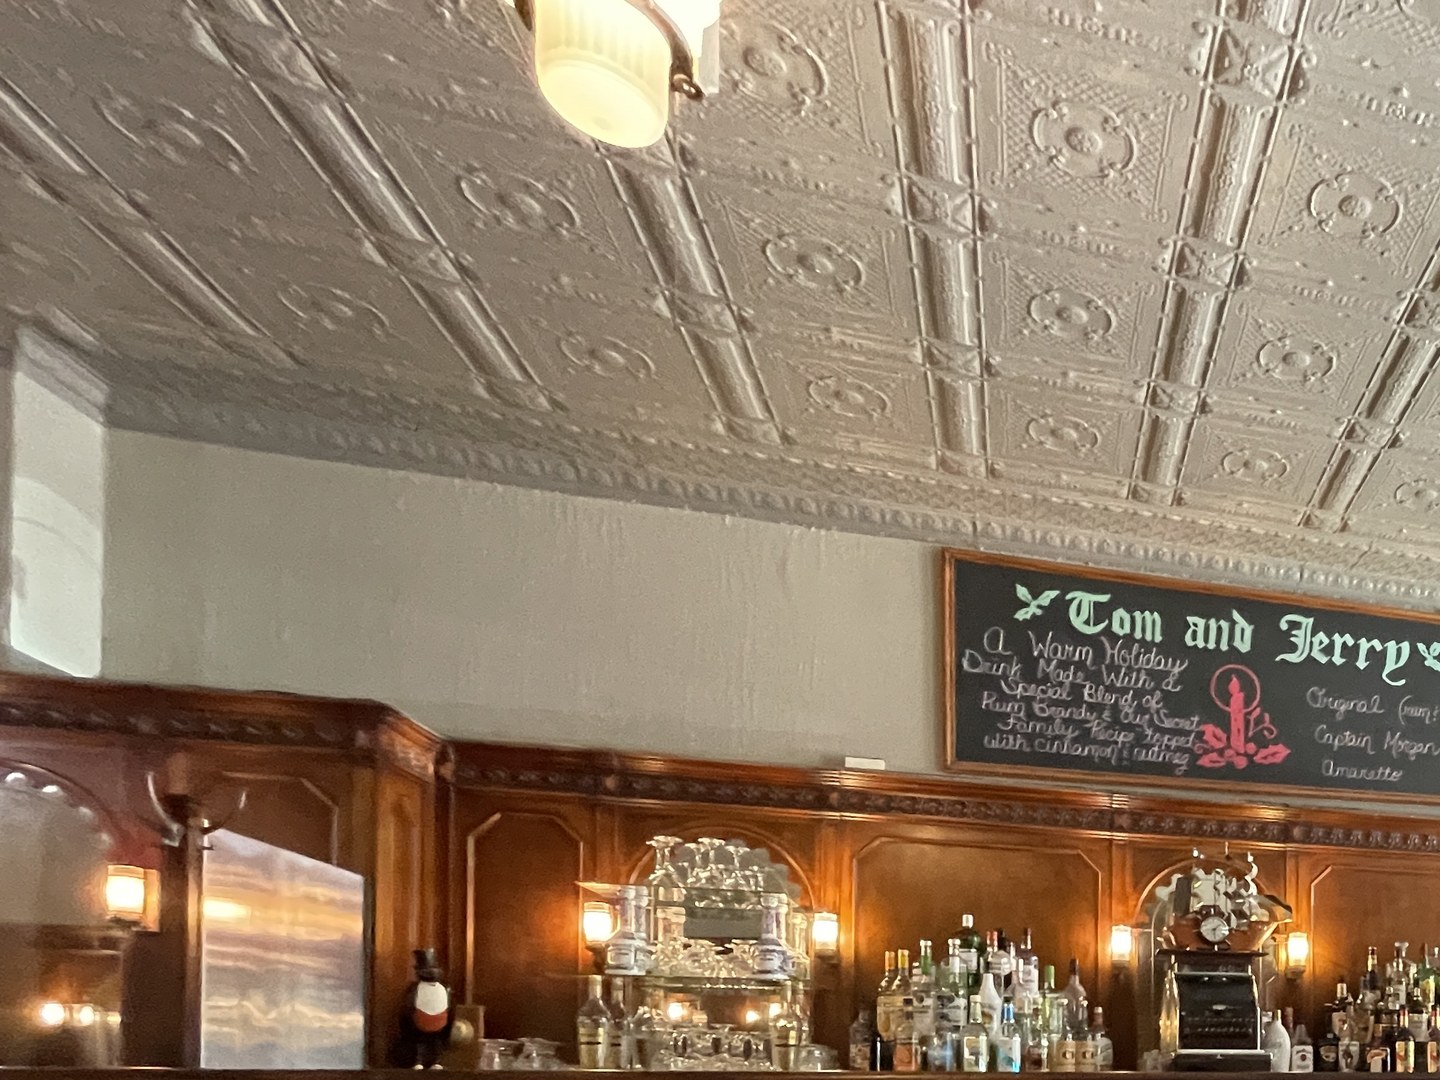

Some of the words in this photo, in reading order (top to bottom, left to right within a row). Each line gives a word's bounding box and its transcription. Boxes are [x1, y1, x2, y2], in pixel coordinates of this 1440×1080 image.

[1028, 631, 1098, 670] Warm
[1100, 636, 1188, 673] Holiday
[1065, 590, 1163, 643] Tom
[1184, 608, 1254, 653] and
[1275, 613, 1410, 686] Jerry
[962, 649, 1023, 682] Drink
[1037, 658, 1089, 684] Made
[1102, 665, 1153, 688] With
[982, 691, 1026, 720] Rum
[1033, 700, 1097, 722] Brandy
[1000, 676, 1072, 700] Special
[1083, 683, 1138, 706] Blend
[1143, 691, 1163, 712] of
[1306, 687, 1385, 721] Original
[998, 715, 1079, 739] Family
[1144, 728, 1195, 750] topped
[1315, 725, 1375, 754] Captain
[1133, 746, 1189, 775] nutmeg
[1321, 759, 1403, 781] Amaretto
